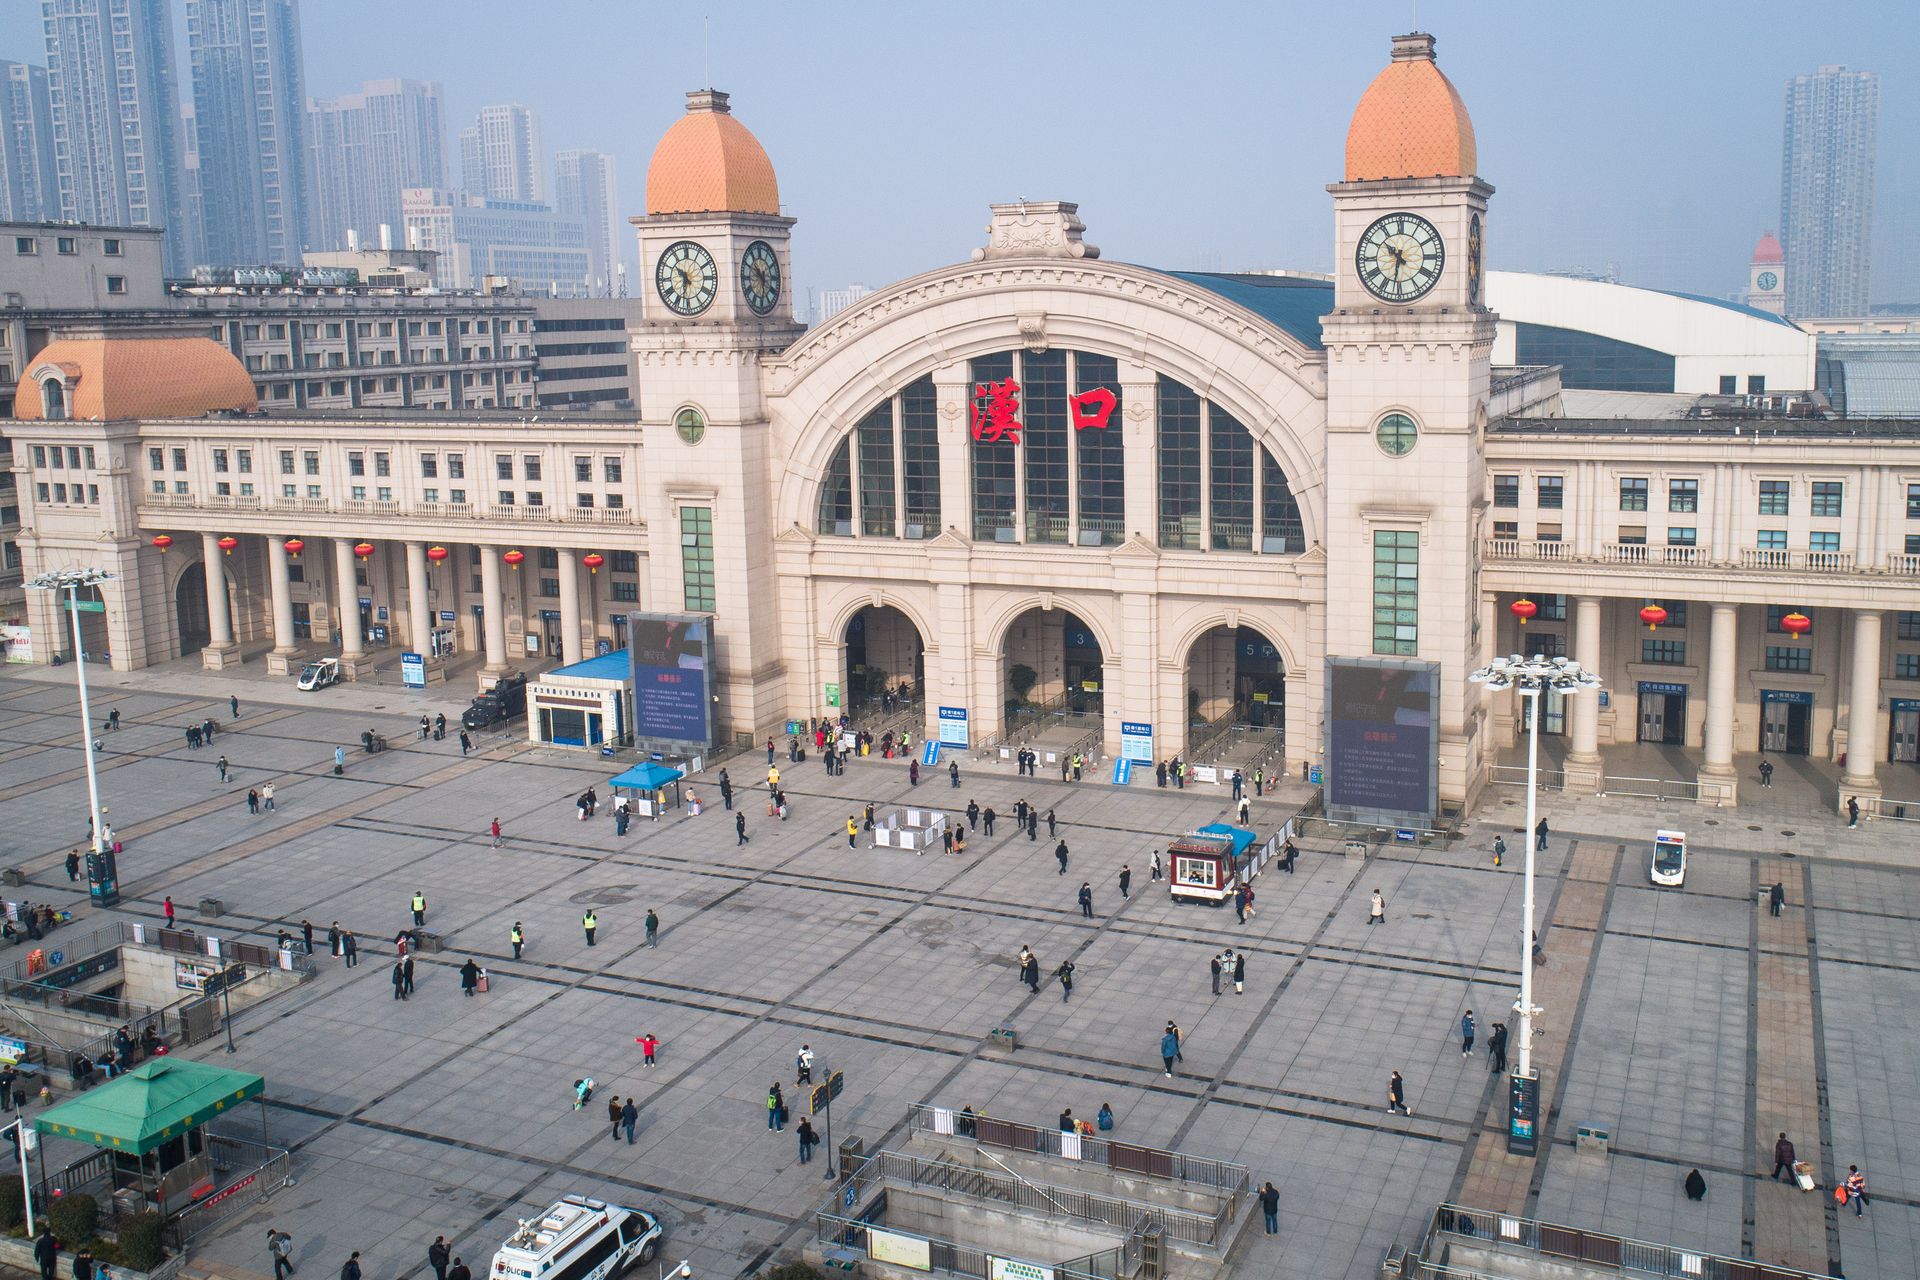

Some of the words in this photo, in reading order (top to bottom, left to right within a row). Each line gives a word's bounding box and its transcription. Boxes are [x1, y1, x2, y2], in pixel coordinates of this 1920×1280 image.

[970, 376, 1117, 445] 漢口
[1077, 633, 1084, 645] 3
[1246, 644, 1254, 656] 5
